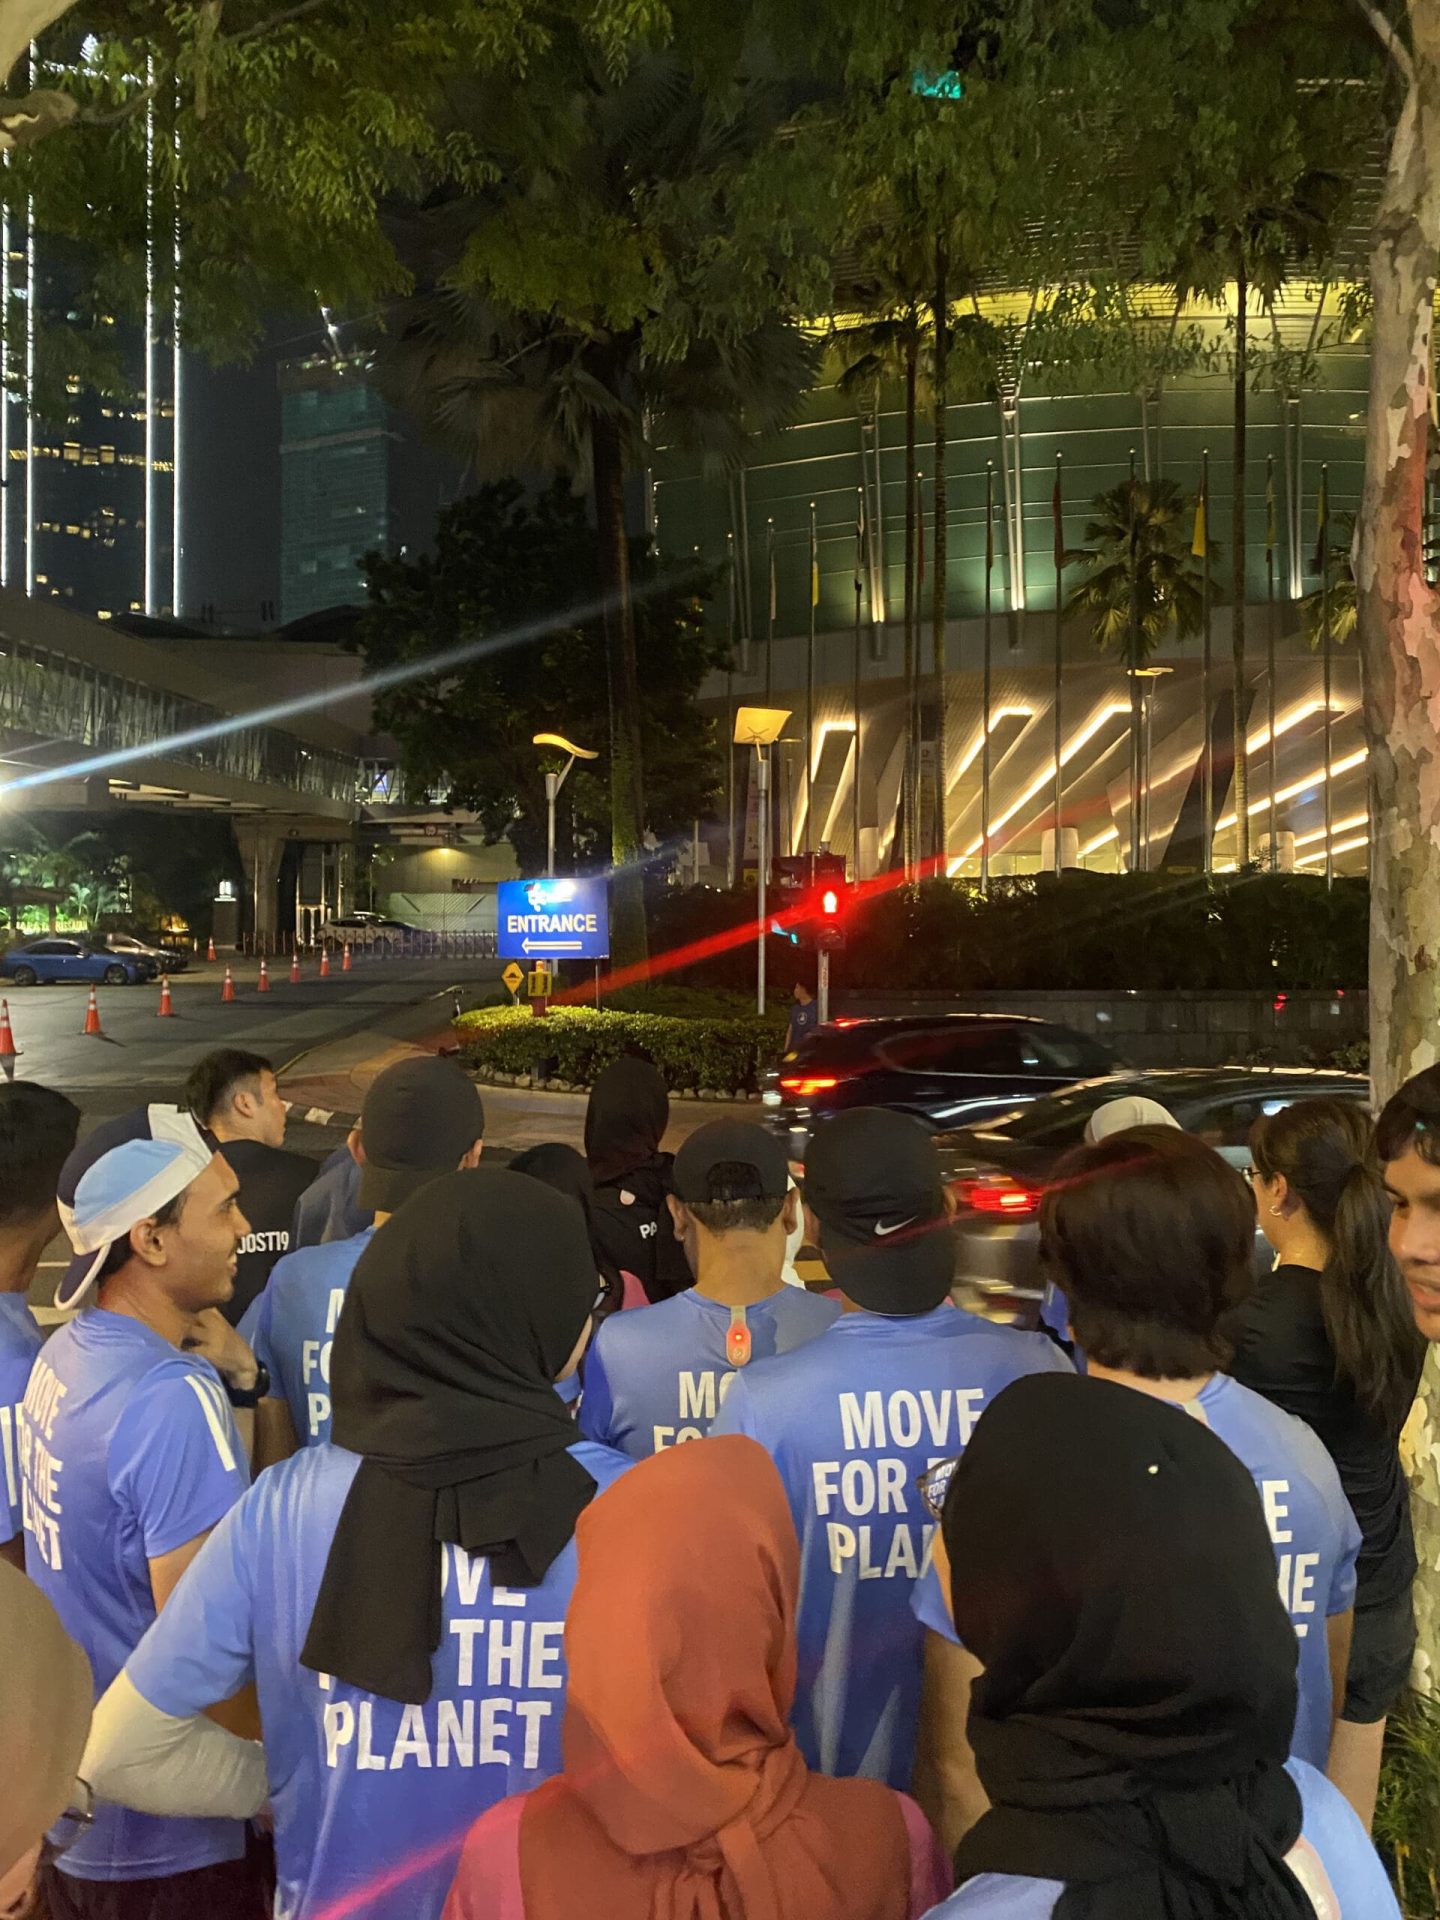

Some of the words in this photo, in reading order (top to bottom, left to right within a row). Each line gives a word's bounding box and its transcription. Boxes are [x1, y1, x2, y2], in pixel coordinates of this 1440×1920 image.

[507, 914, 598, 933] ENTRANCE
[812, 1458, 908, 1516] FOR
[449, 1618, 566, 1689] THE
[323, 1697, 552, 1771] PLANET
